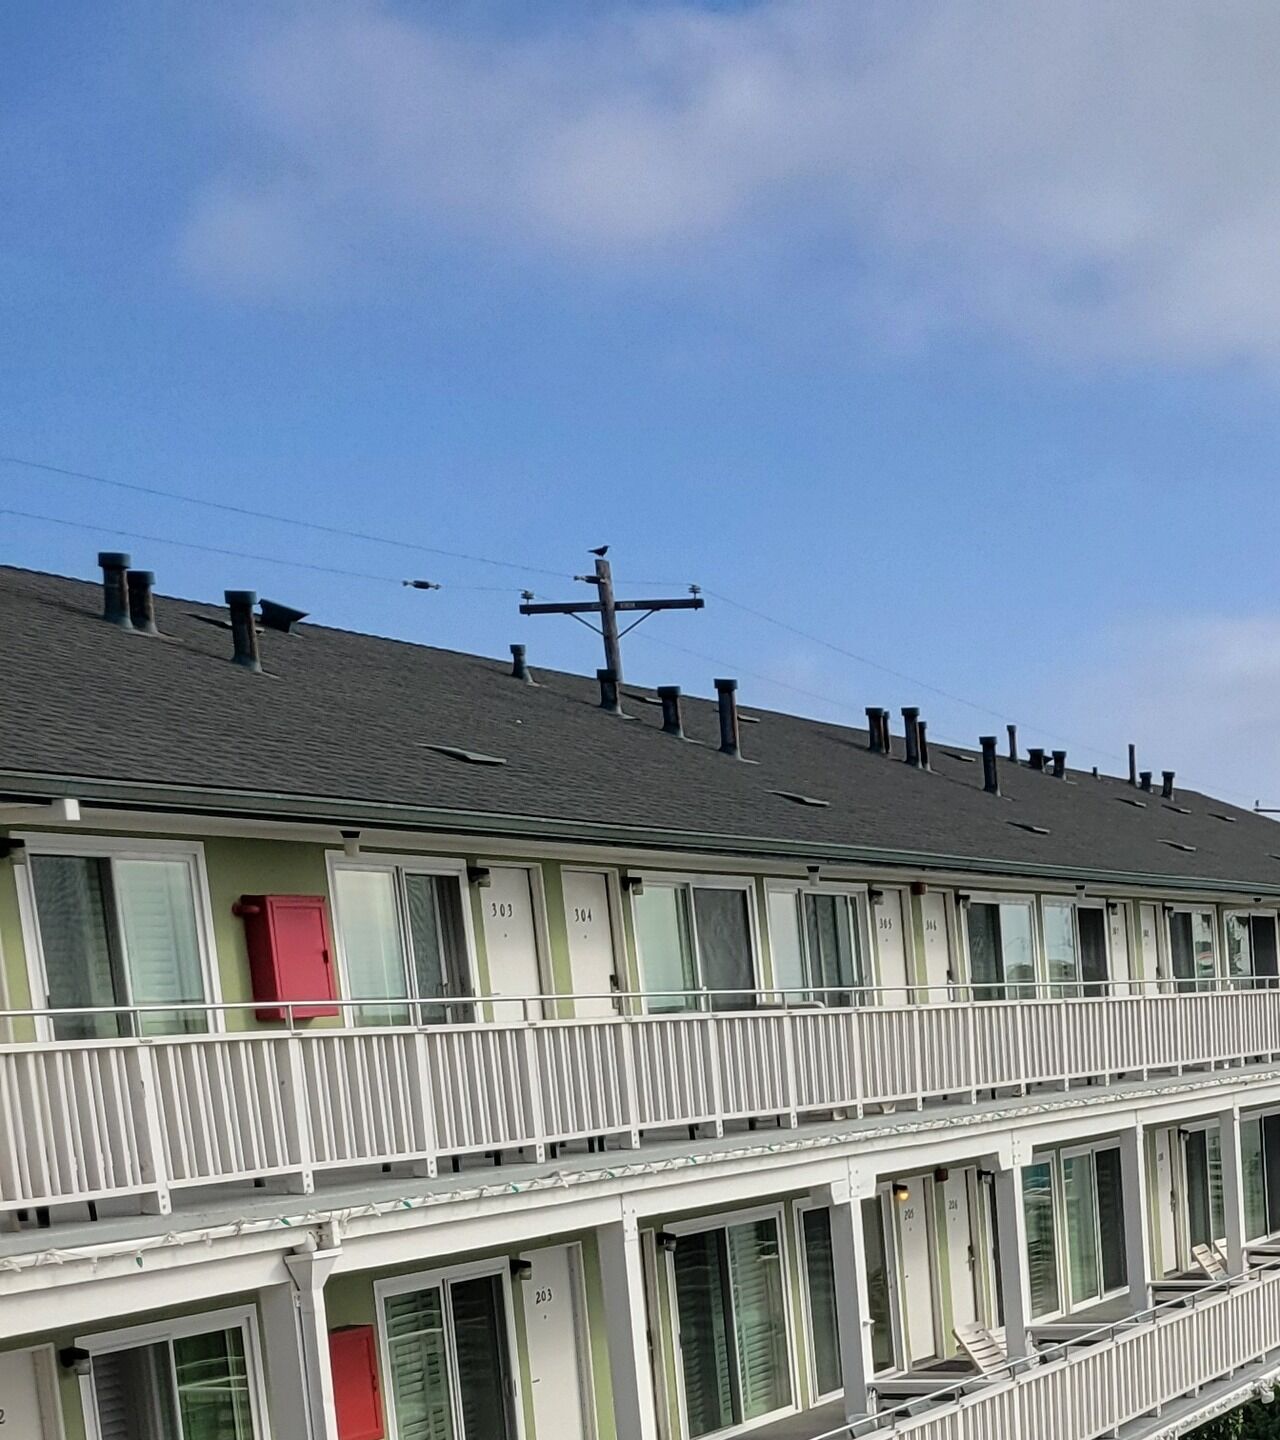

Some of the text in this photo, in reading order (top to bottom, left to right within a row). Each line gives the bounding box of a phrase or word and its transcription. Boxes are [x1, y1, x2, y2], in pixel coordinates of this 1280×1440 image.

[491, 902, 513, 918] 303
[574, 908, 592, 922] 304
[535, 1288, 553, 1305] 203
